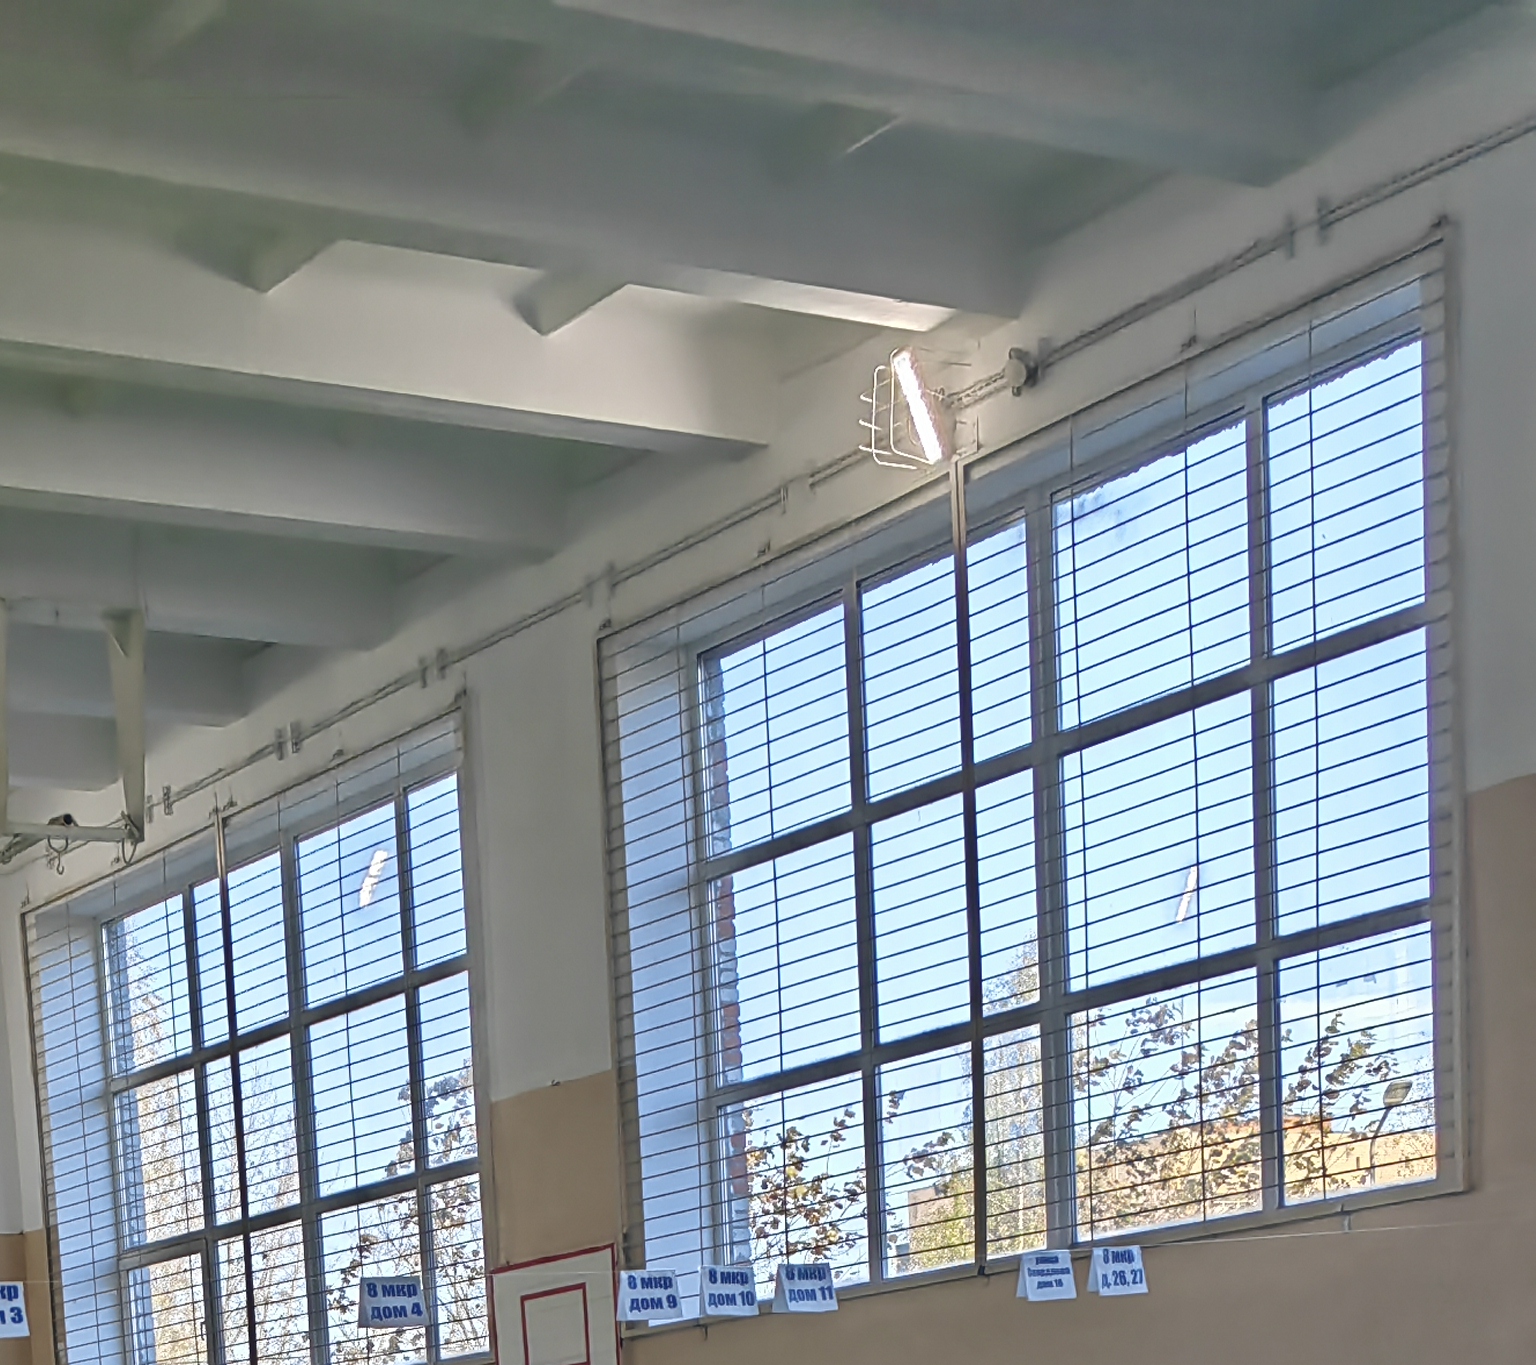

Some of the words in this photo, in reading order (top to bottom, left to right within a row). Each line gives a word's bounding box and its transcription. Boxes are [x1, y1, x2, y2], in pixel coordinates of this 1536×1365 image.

[1102, 1248, 1110, 1265] 8
[708, 1268, 718, 1285] 8
[785, 1265, 795, 1280] 8
[1131, 1268, 1144, 1285] 27
[366, 1282, 378, 1298] 8
[627, 1274, 637, 1290] 8
[738, 1290, 755, 1306] 10
[818, 1285, 833, 1301] 11
[411, 1302, 423, 1317] 4
[666, 1294, 678, 1309] 9
[9, 1306, 24, 1324] 3
